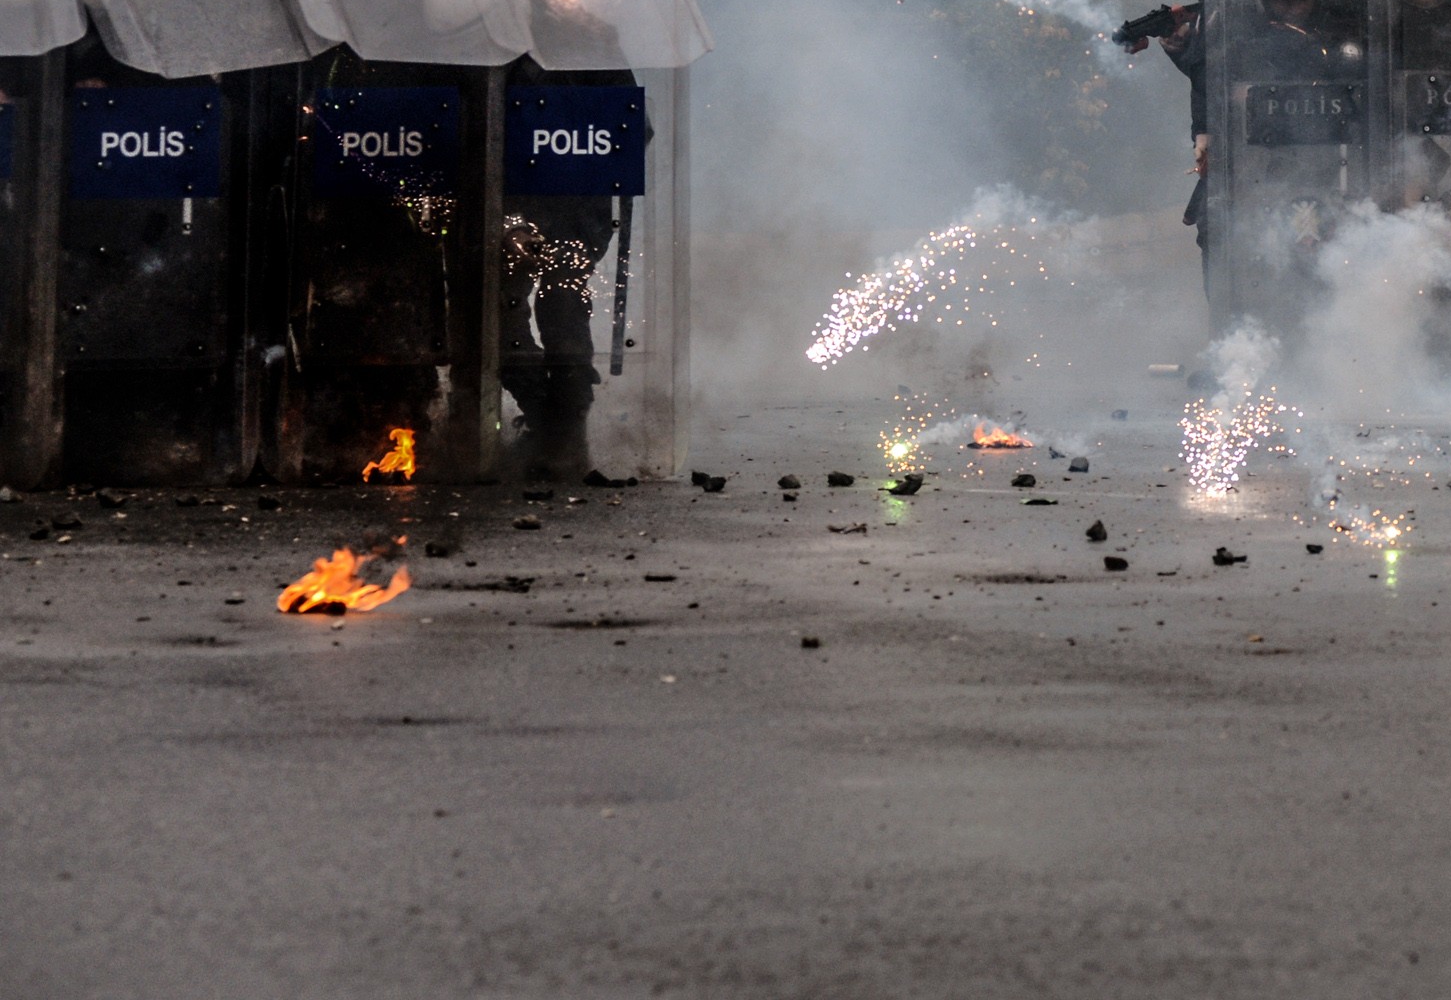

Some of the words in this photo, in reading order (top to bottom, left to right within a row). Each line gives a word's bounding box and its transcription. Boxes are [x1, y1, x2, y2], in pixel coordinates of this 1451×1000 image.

[101, 126, 185, 158] POLİS
[342, 126, 423, 157] POLİS
[532, 124, 612, 155] POLİS
